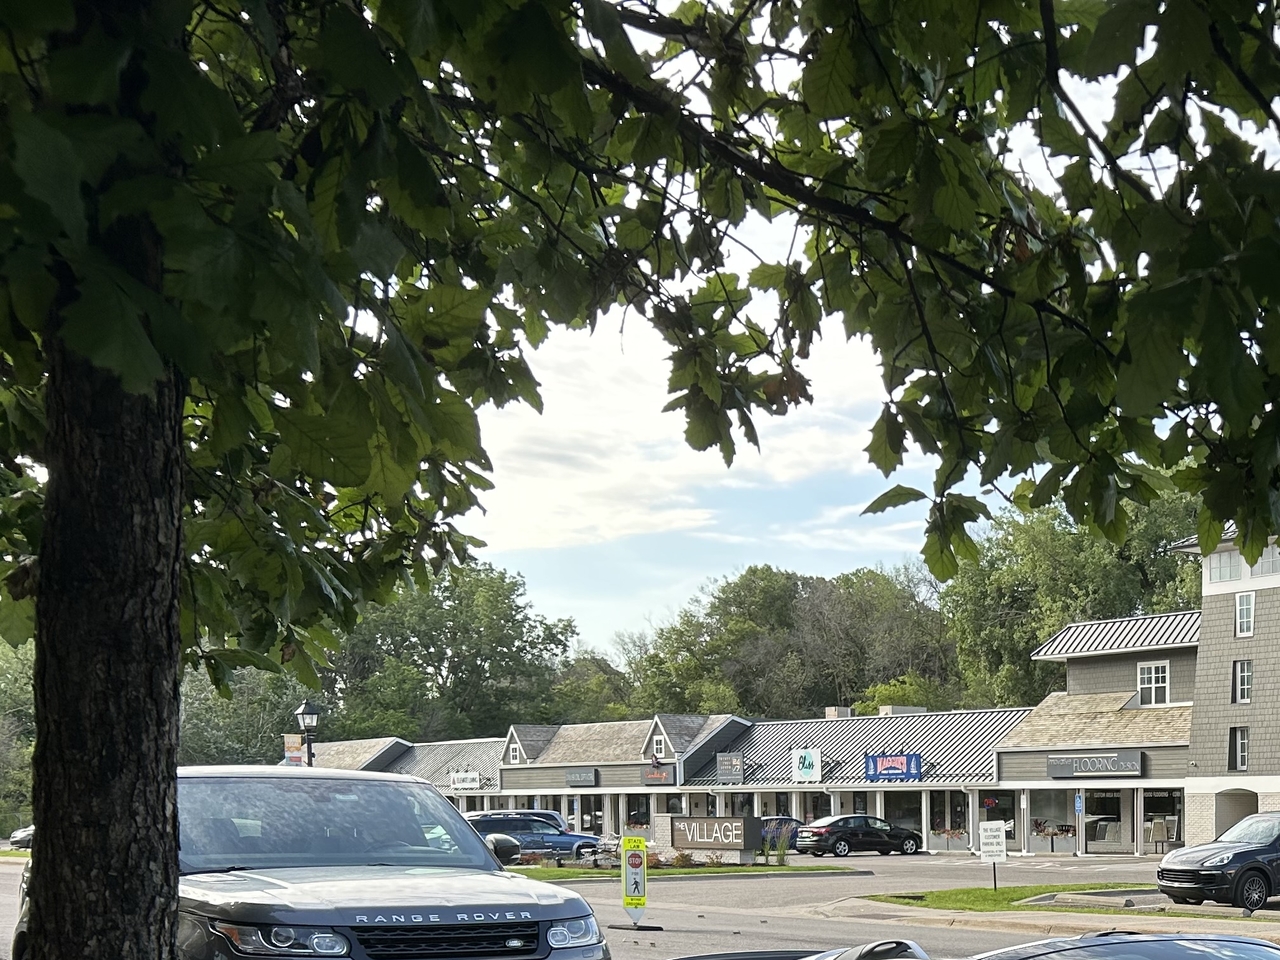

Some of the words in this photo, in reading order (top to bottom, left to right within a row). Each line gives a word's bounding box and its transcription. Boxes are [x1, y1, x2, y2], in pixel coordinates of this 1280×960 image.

[1073, 757, 1118, 772] FLOORING
[675, 822, 685, 830] THE
[685, 822, 742, 843] VILLAGE
[355, 914, 441, 923] RANGE
[456, 911, 532, 921] ROVER
